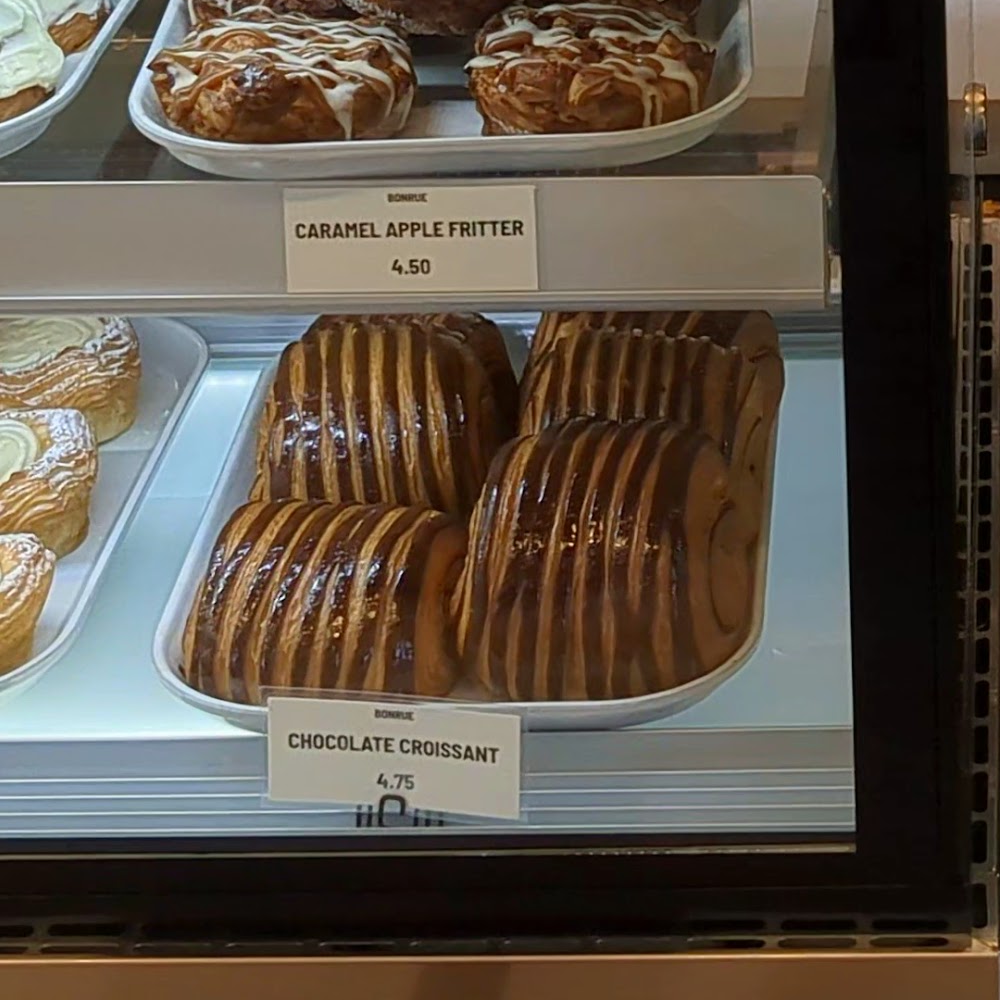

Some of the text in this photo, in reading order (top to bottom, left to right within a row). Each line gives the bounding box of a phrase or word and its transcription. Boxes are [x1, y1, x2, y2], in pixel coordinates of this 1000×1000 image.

[387, 193, 428, 203] BONRUE
[295, 220, 525, 239] CARAMEL APPLE FRITTER
[391, 259, 432, 275] 4.50
[374, 709, 414, 721] BONRUE
[288, 733, 500, 764] CHOCOLATE CROISSANT
[376, 773, 415, 790] 4.75
